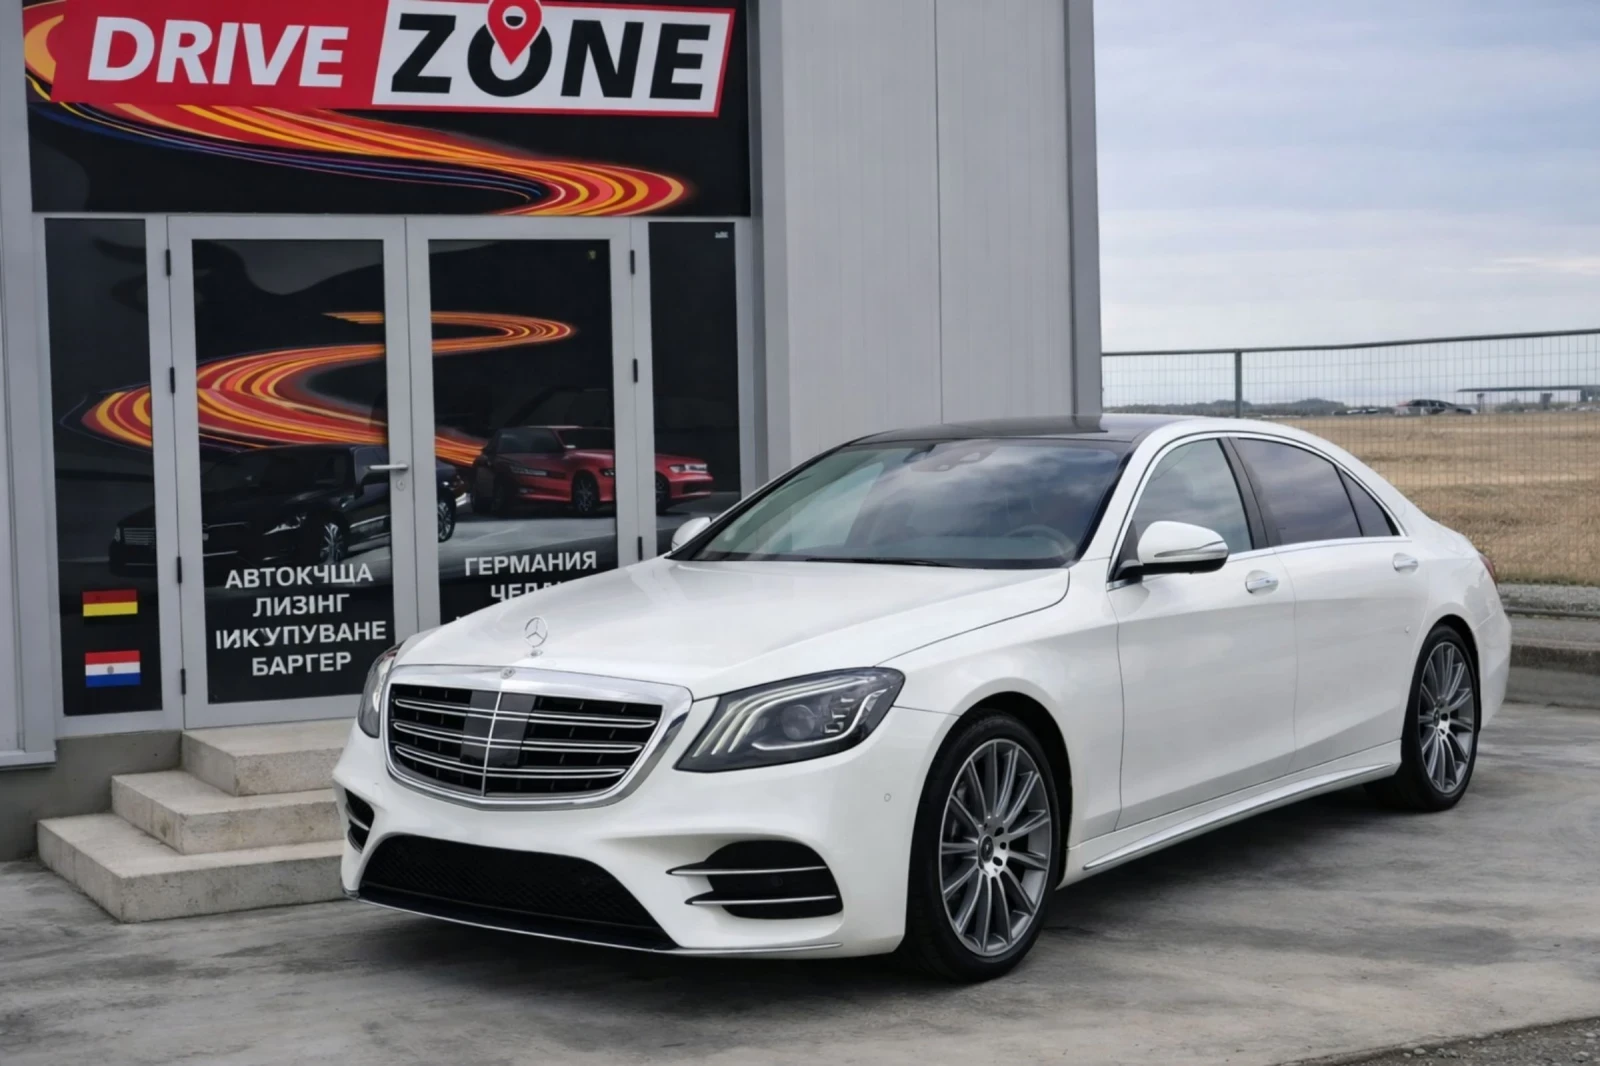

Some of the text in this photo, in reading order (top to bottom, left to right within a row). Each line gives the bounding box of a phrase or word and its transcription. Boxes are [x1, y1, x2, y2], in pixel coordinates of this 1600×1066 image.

[88, 13, 711, 100] DRIVE ZONE
[464, 550, 597, 577] ГЕРМАНИЯ
[252, 652, 352, 677] БАРГЕР
